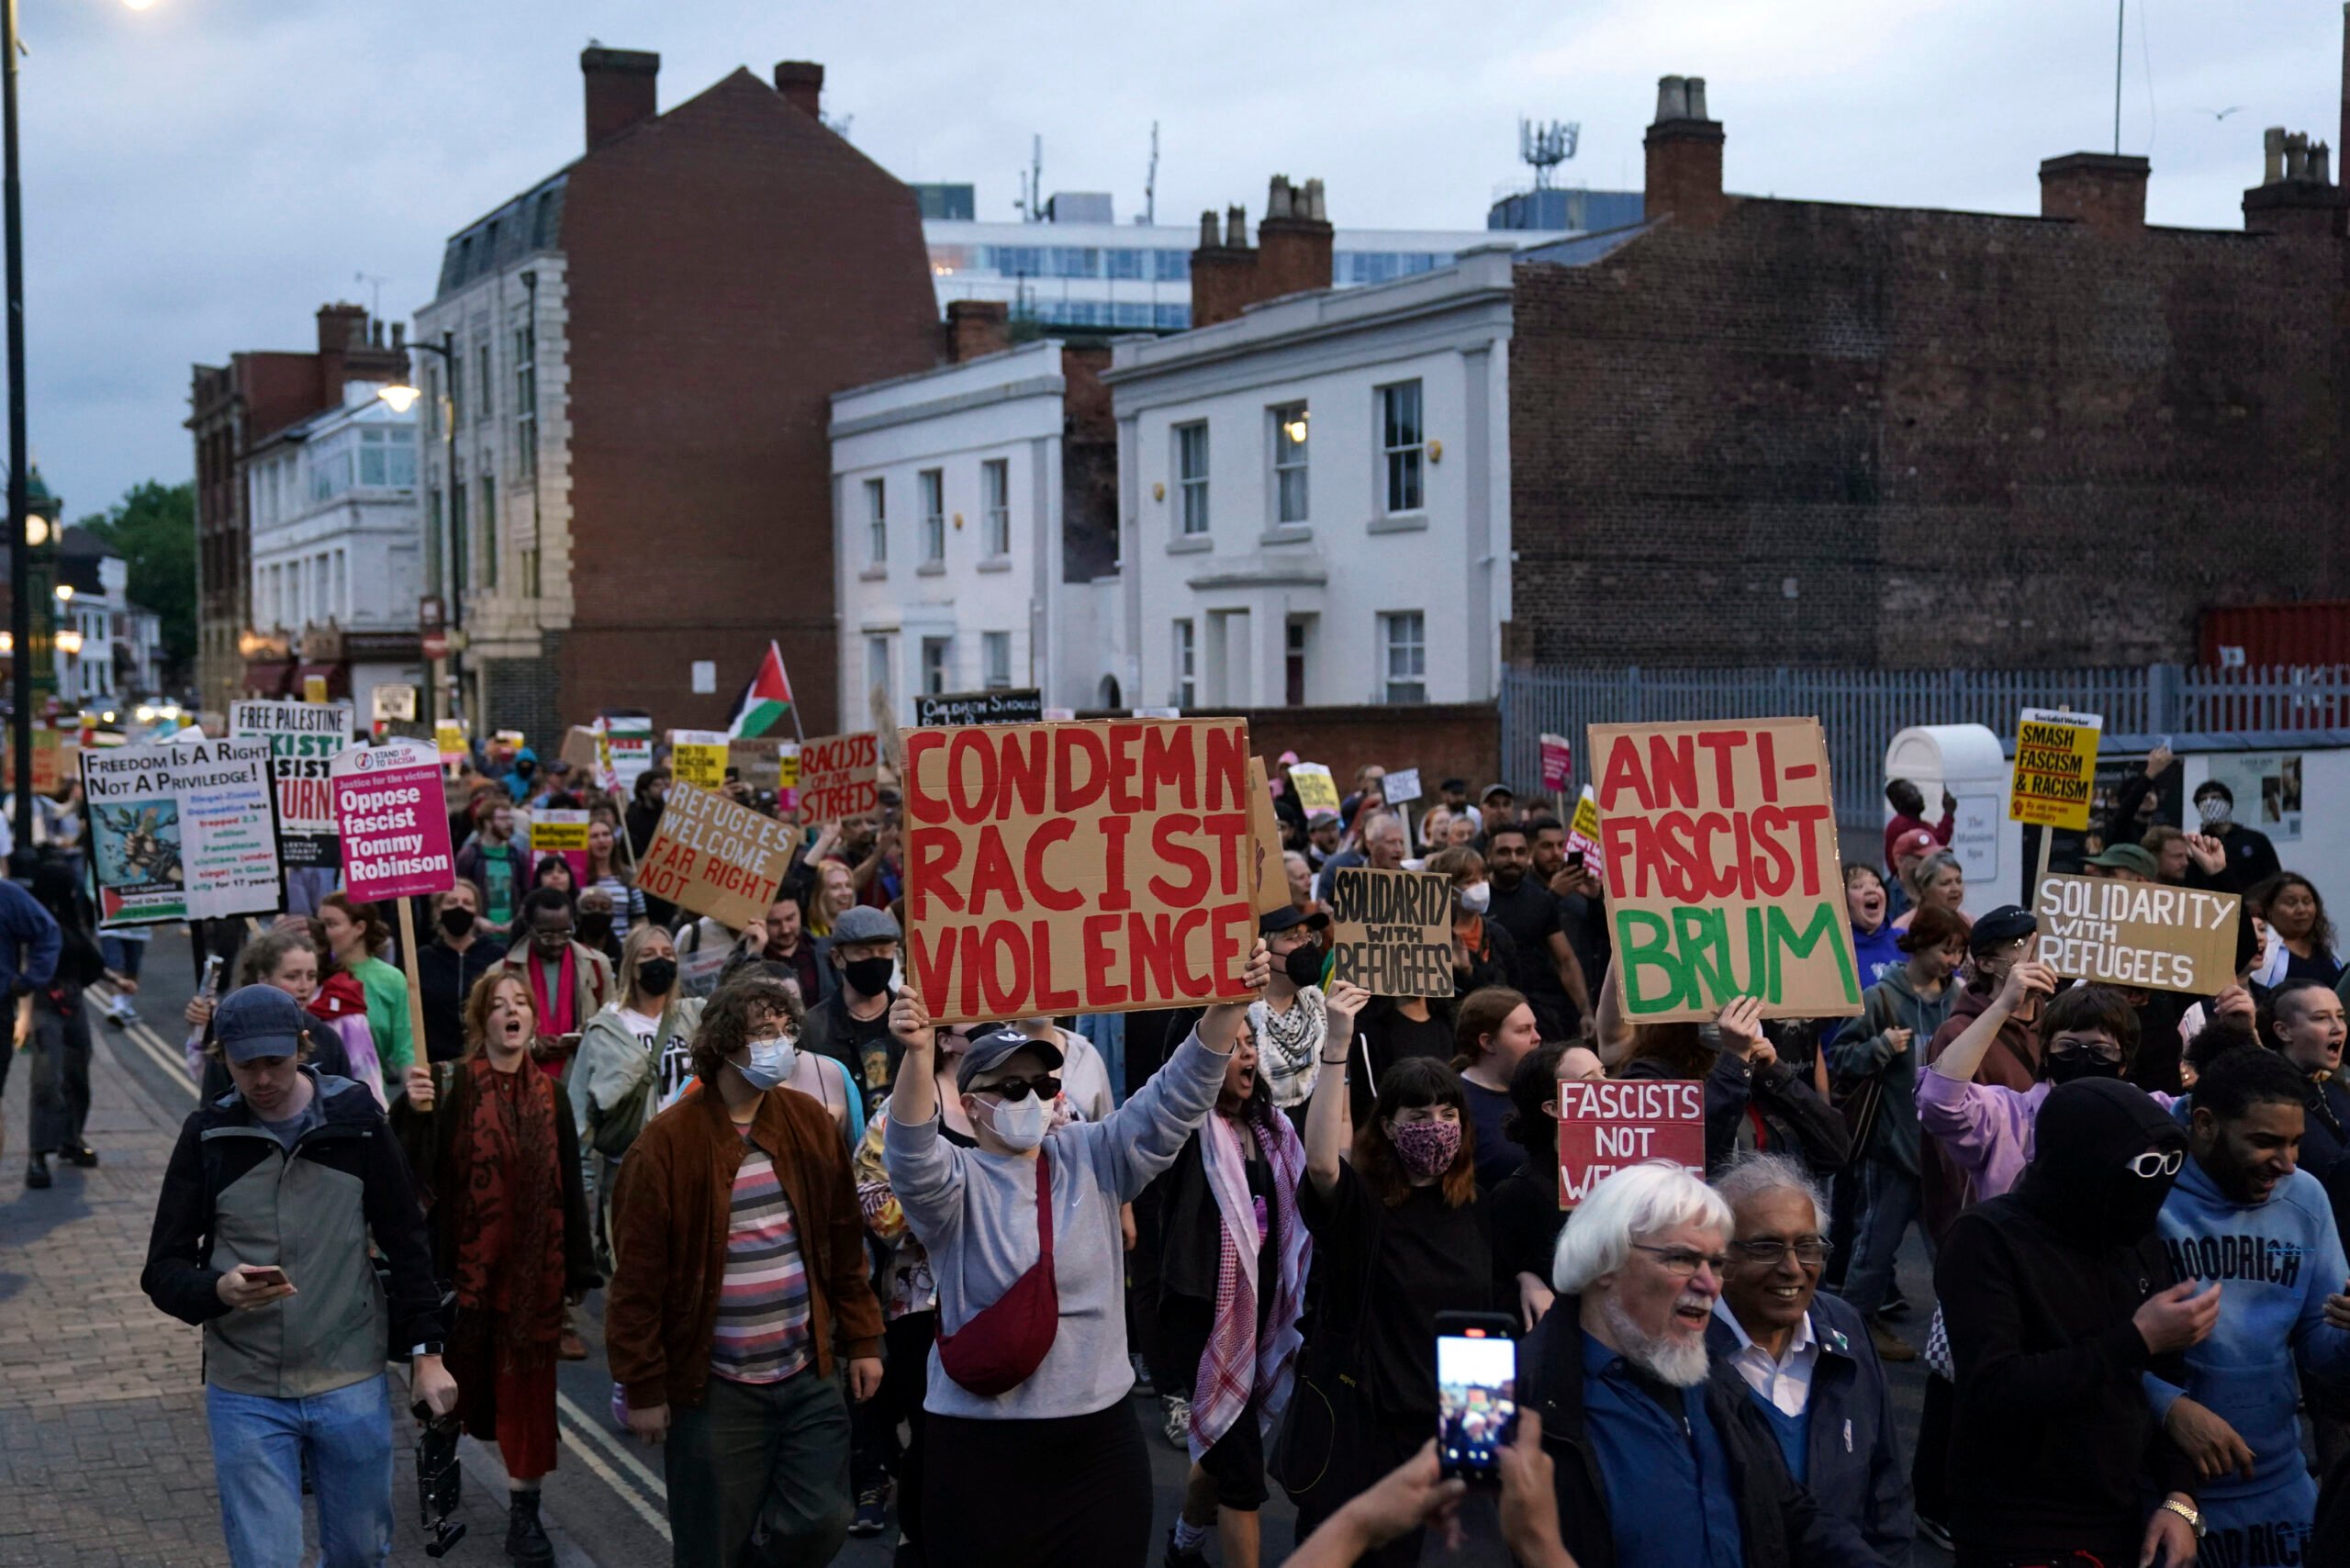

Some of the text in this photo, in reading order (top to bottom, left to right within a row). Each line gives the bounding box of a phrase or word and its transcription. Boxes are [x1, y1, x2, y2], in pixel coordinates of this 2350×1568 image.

[239, 706, 344, 733] FREE PALESTINE
[2034, 713, 2090, 725] Socialist Worker
[2022, 724, 2076, 747] SMASH
[193, 745, 209, 765] A
[375, 748, 412, 760] STAND UP
[376, 756, 417, 767] TO RACISM
[695, 746, 708, 756] TO
[800, 734, 878, 778] RACISTS
[2019, 749, 2083, 775] FASCISM
[135, 774, 152, 794] A
[338, 769, 437, 790] Justice for the victims
[907, 725, 1245, 825] CONDEMN
[1599, 730, 1818, 812] ANTI-
[2015, 773, 2088, 800] & RACISM
[341, 787, 421, 815] Oppose
[800, 778, 878, 825] STREETS
[199, 817, 240, 828] trapped
[342, 807, 417, 835] fascist
[670, 781, 792, 852] REFUGEES
[535, 825, 585, 837] Refugees
[535, 839, 582, 847] welcome
[663, 811, 772, 875] WELCOME
[203, 842, 261, 852] Palestinian
[345, 834, 423, 858] Tommy
[1602, 804, 1830, 904] FASCIST
[349, 854, 448, 882] Robinson
[637, 861, 690, 901] NOT
[650, 835, 777, 904] FAR RIGHT
[911, 813, 1247, 922] RACIST
[1333, 871, 1451, 926] SOLIDARITY
[2041, 879, 2235, 931] SOLIDARITY
[1366, 924, 1424, 944] WITH
[2049, 916, 2117, 944] WITH
[913, 902, 1258, 1018] VIOLENCE
[1335, 942, 1454, 996] REFUGEES
[1617, 902, 1860, 1014] BRUM
[2038, 935, 2193, 988] REFUGEES
[1561, 1082, 1700, 1119] FASCISTS
[1595, 1126, 1655, 1158] NOT
[2162, 1235, 2302, 1289] HOODRICH
